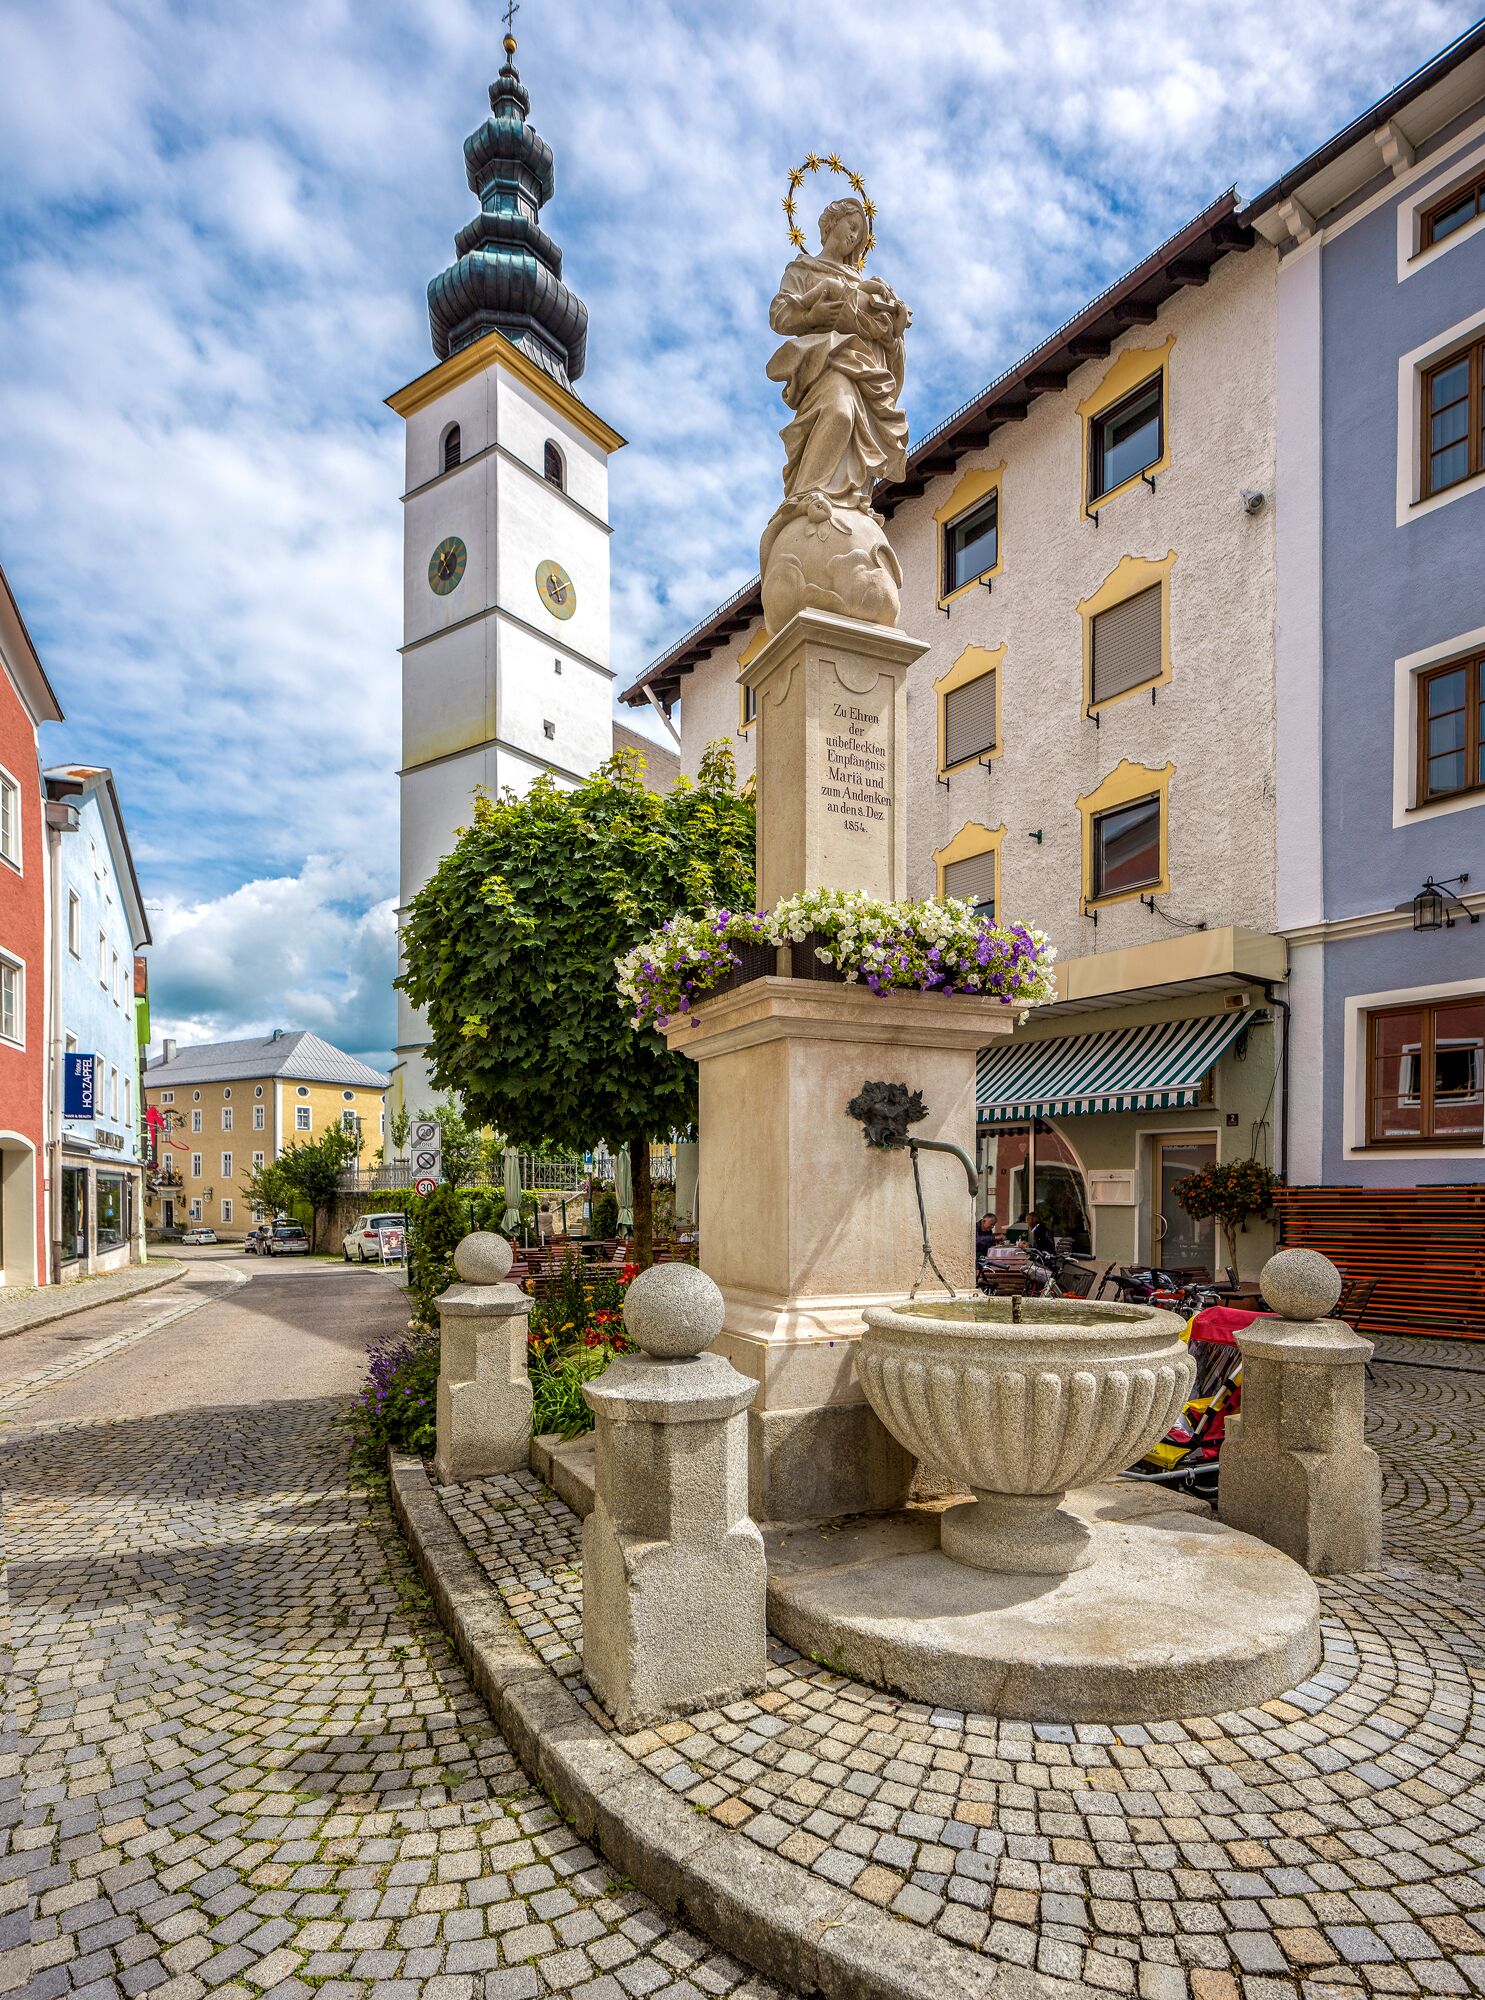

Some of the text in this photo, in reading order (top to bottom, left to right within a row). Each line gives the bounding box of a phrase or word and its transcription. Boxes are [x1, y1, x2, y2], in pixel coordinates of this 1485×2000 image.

[833, 703, 879, 724] Zu Ehren
[848, 723, 865, 736] der
[827, 749, 886, 772] Empfängnis
[828, 766, 884, 789] Mariä und
[821, 786, 840, 798] zum
[827, 802, 839, 813] an
[840, 801, 857, 816] den
[82, 1057, 93, 1108] HOLZAPFEL
[420, 1128, 432, 1137] 20
[585, 1150, 591, 1162] P
[420, 1183, 433, 1193] 30
